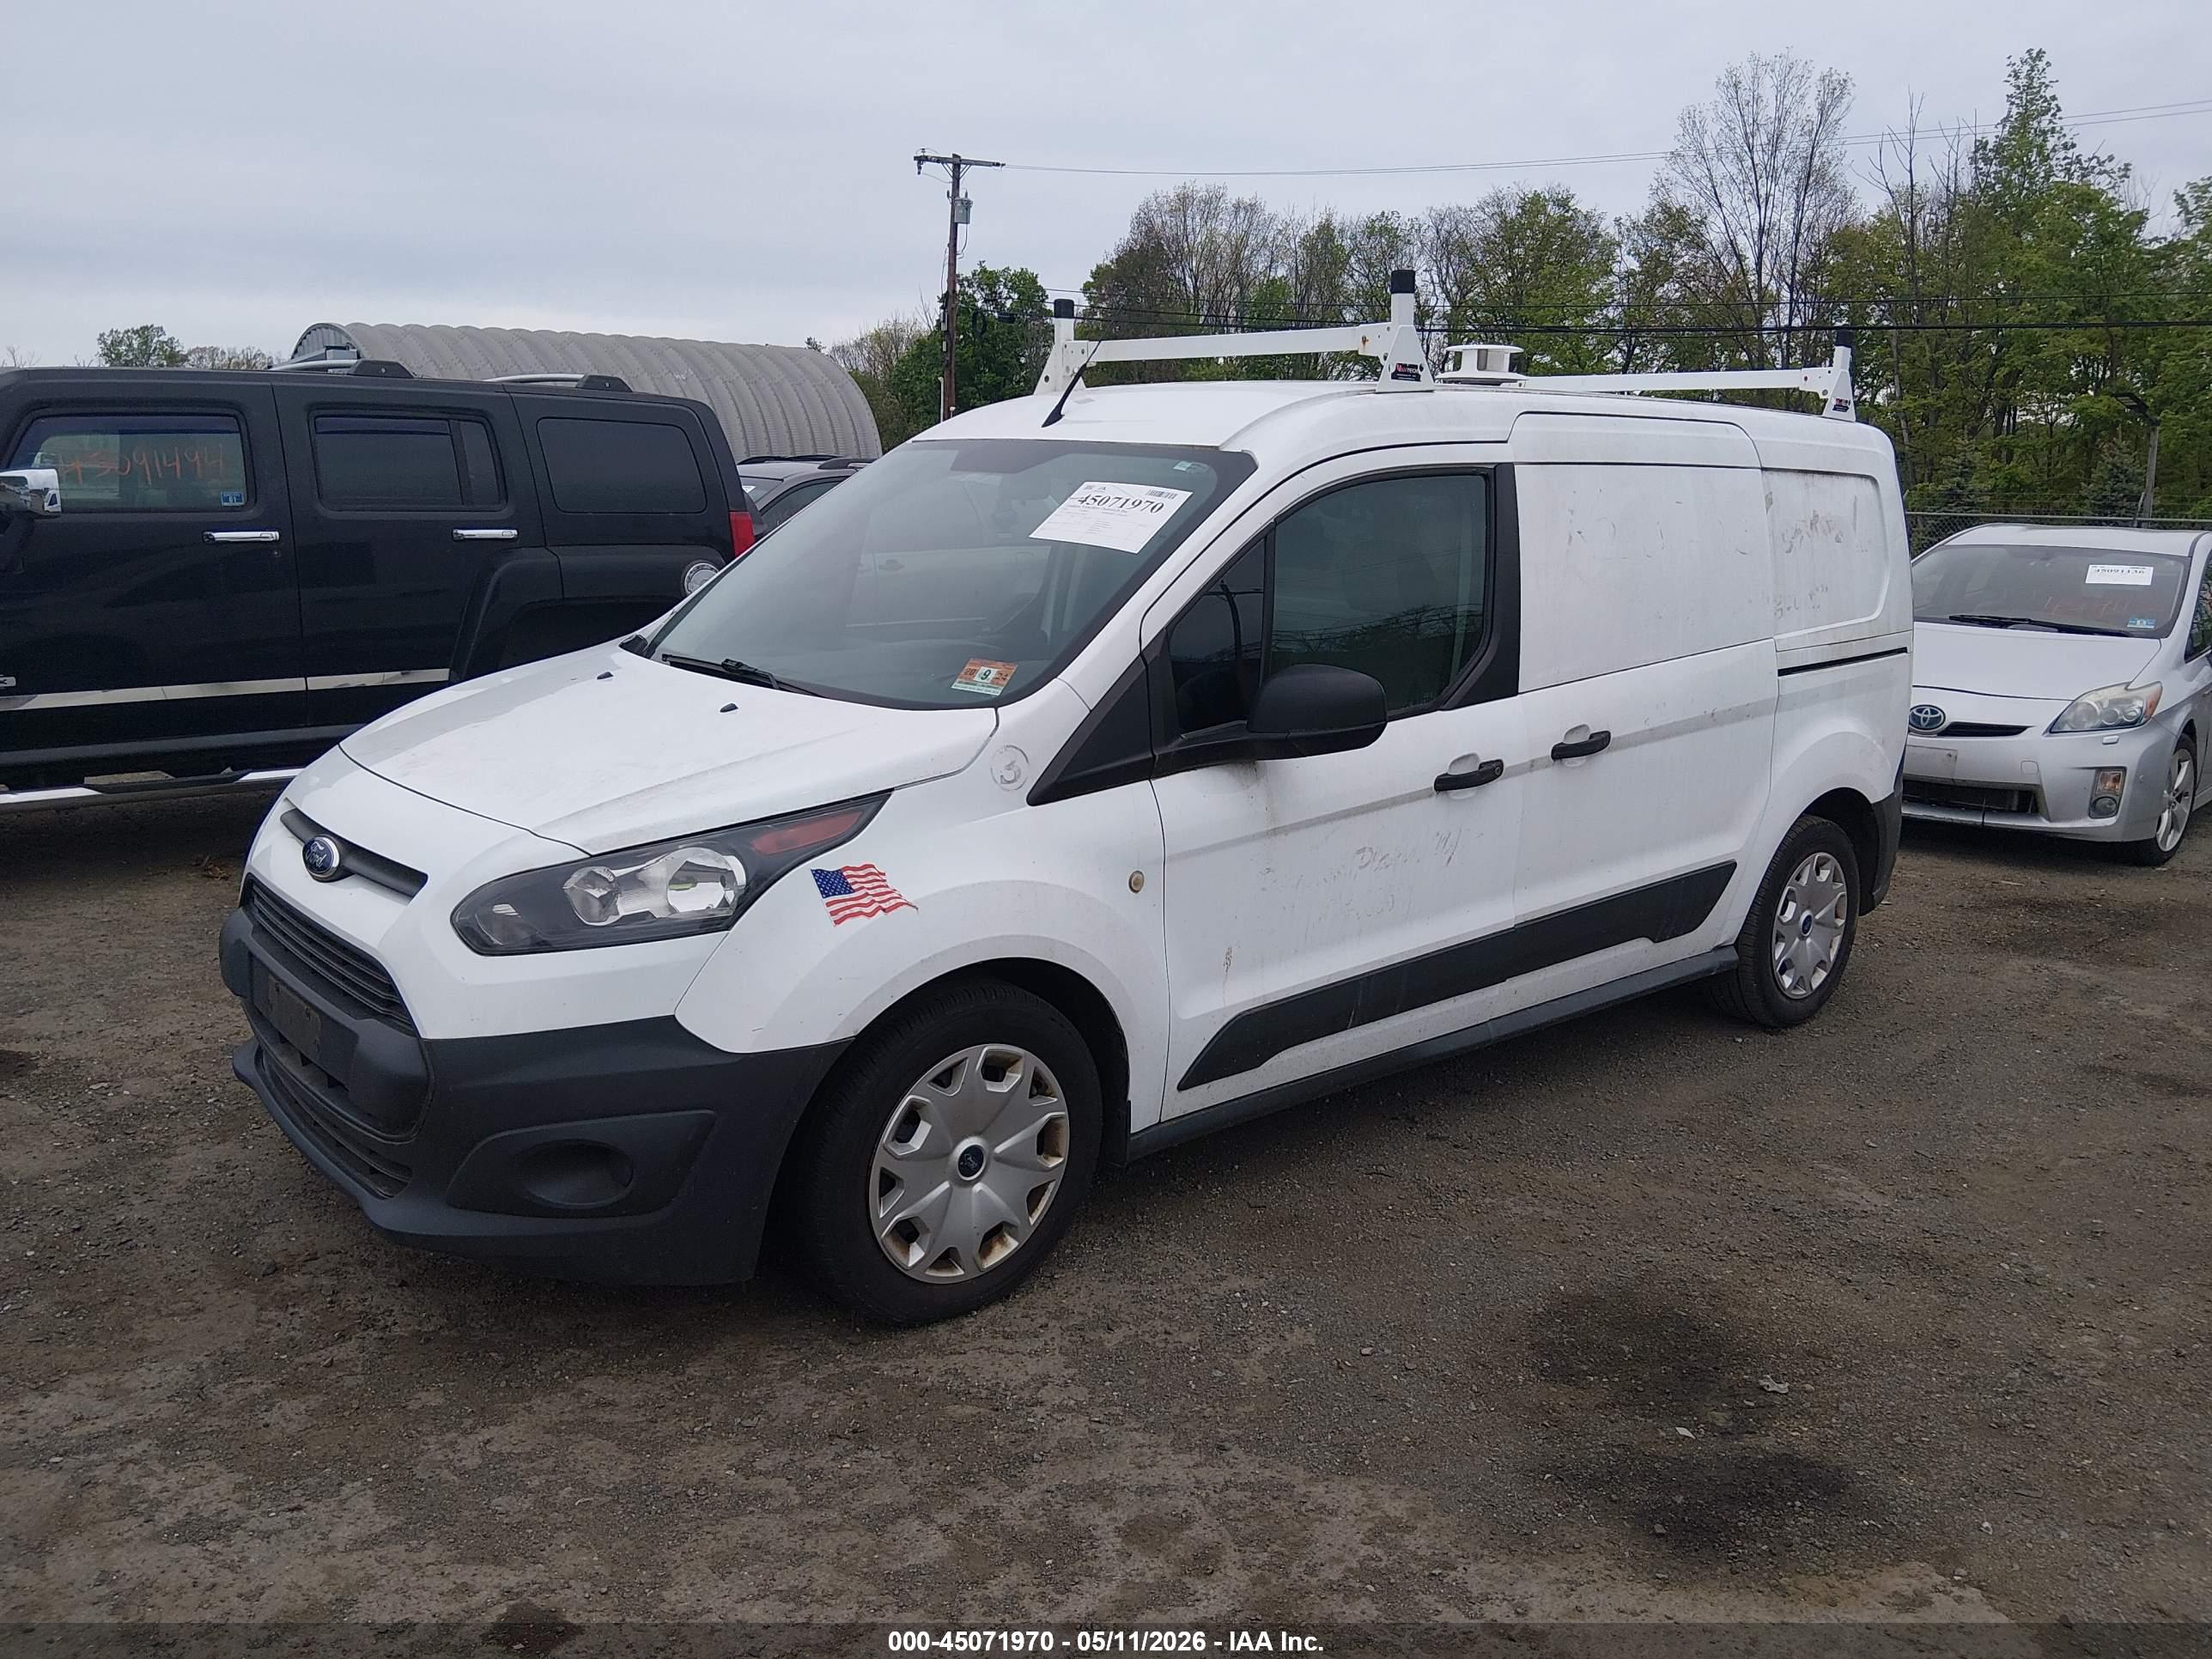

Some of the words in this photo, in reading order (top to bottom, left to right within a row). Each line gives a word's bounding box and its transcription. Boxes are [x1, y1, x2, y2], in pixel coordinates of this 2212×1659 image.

[1078, 494, 1164, 514] 45071970
[981, 670, 992, 680] 9
[306, 842, 327, 868] Ford
